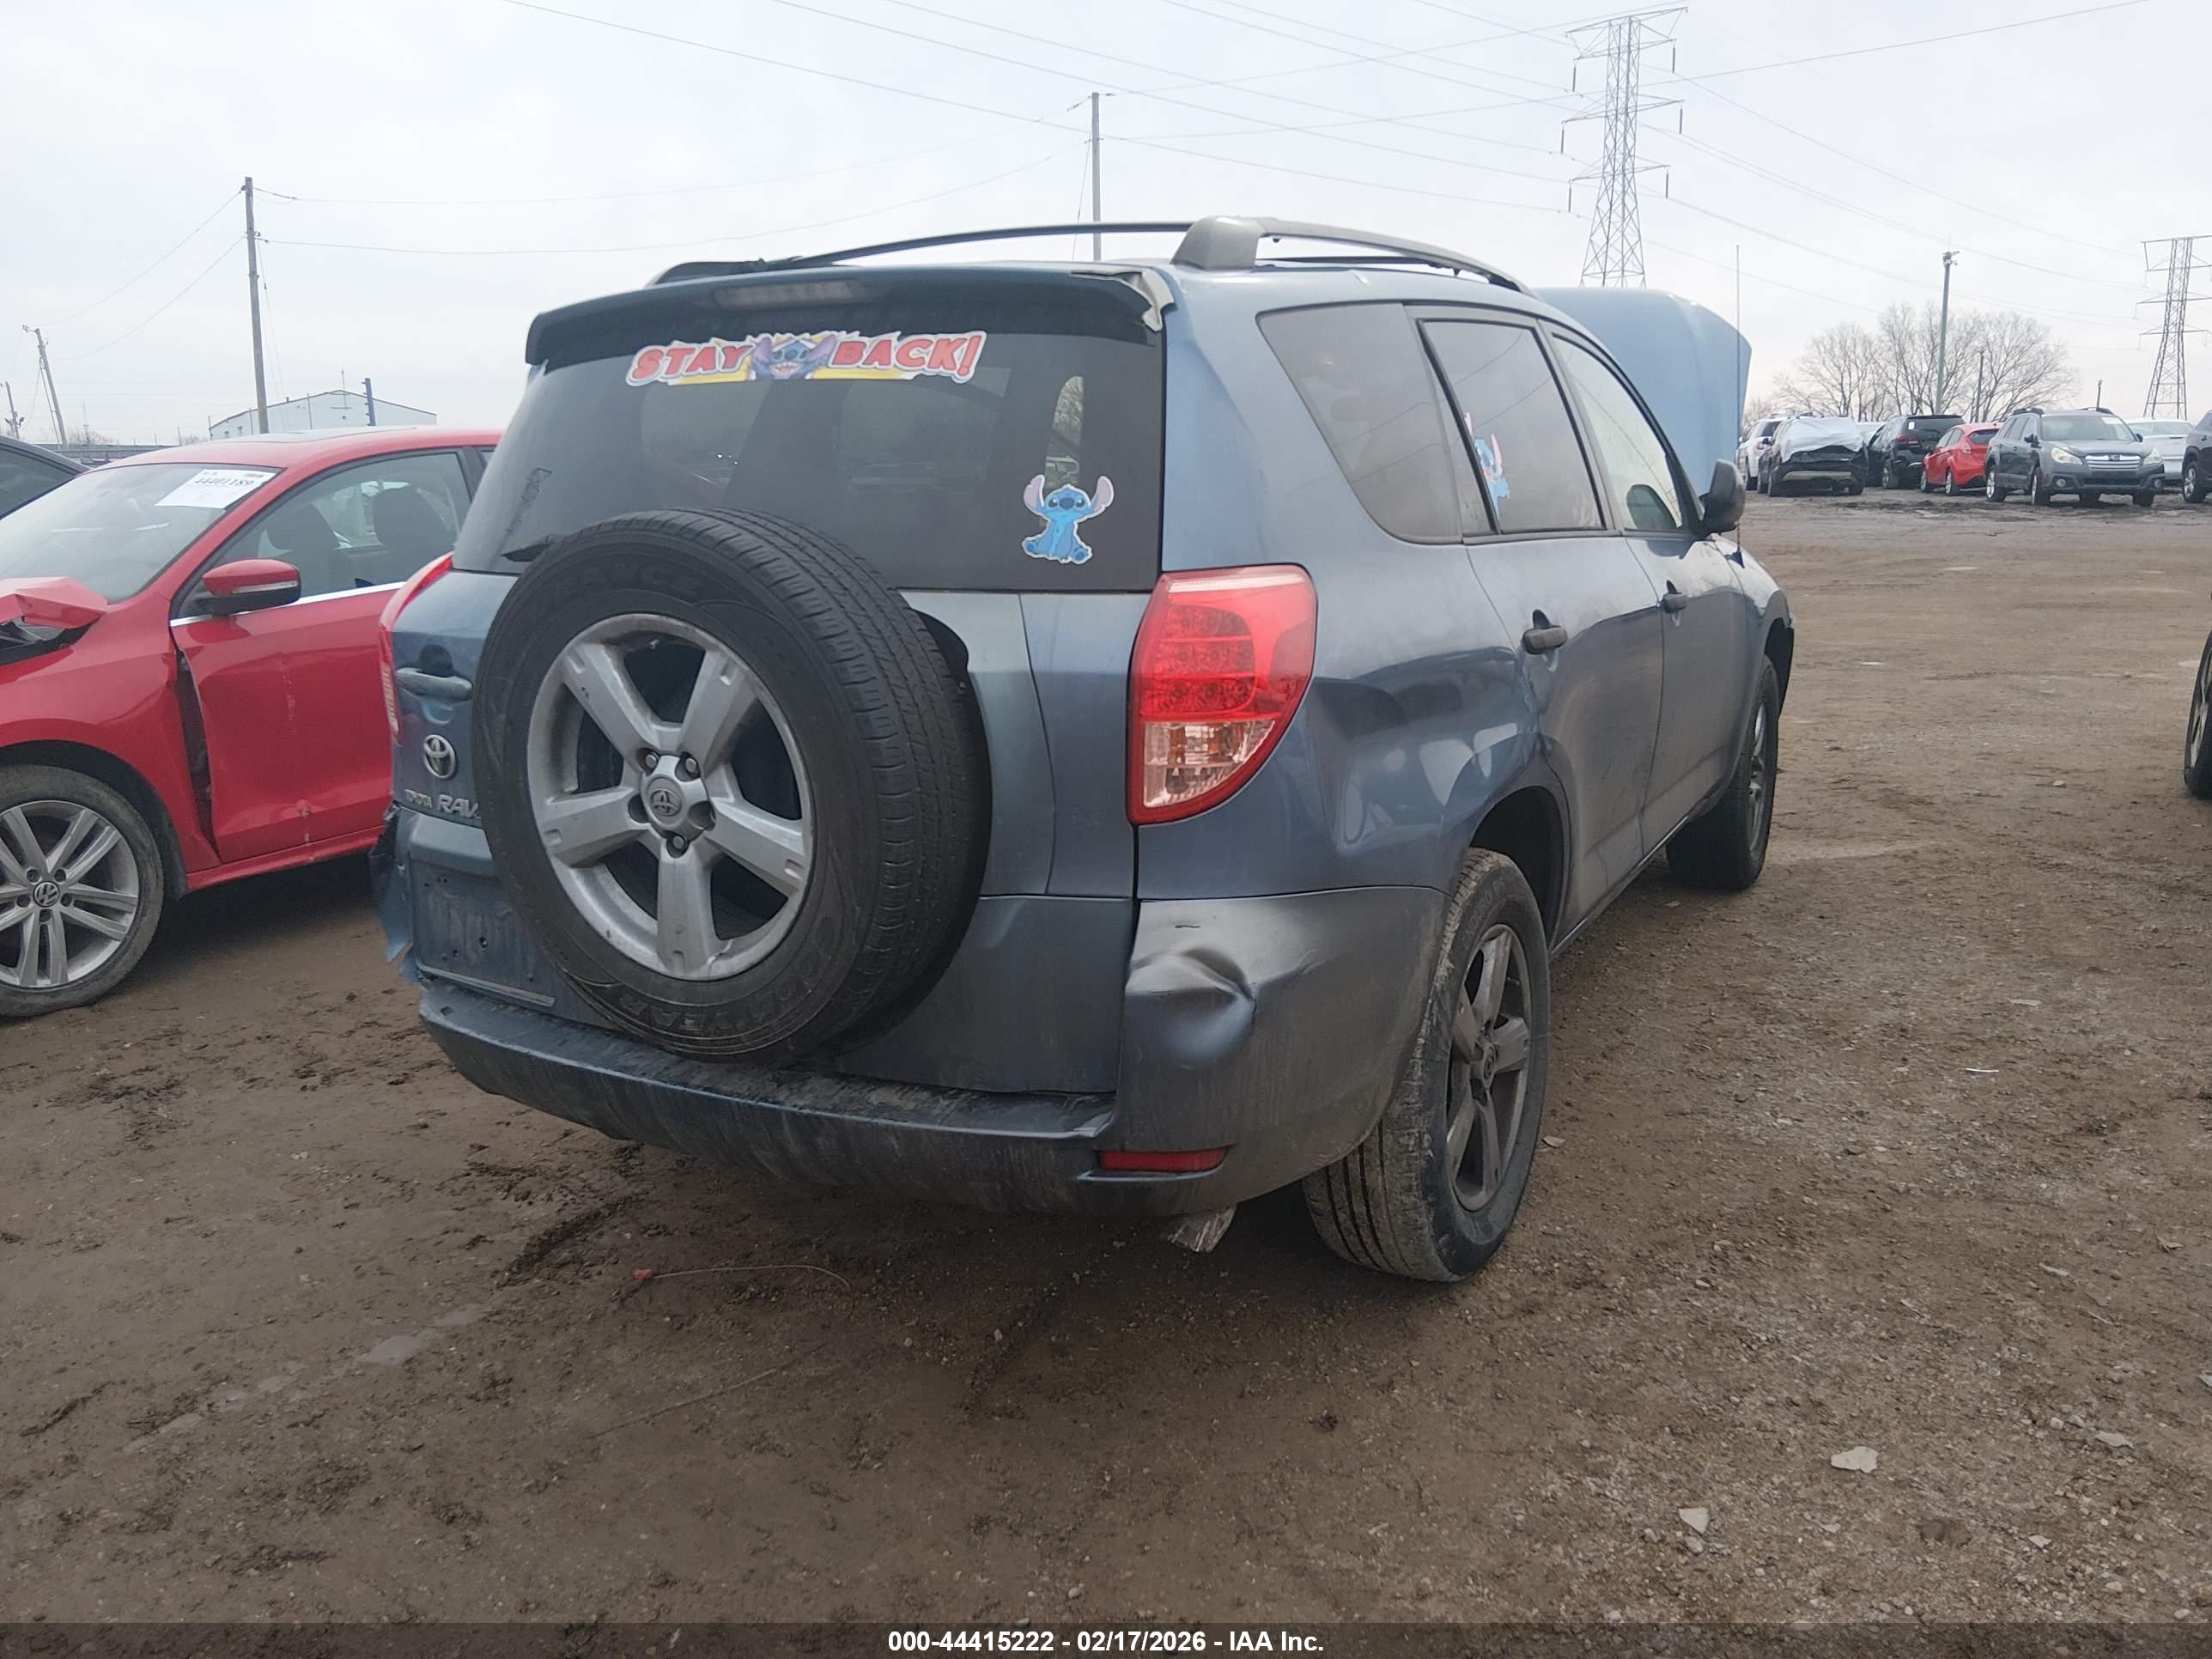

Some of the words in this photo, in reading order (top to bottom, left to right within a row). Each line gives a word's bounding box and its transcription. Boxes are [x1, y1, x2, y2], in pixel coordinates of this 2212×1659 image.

[629, 344, 755, 381] STAY
[830, 334, 985, 380] BACK!
[437, 793, 482, 820] RAV
